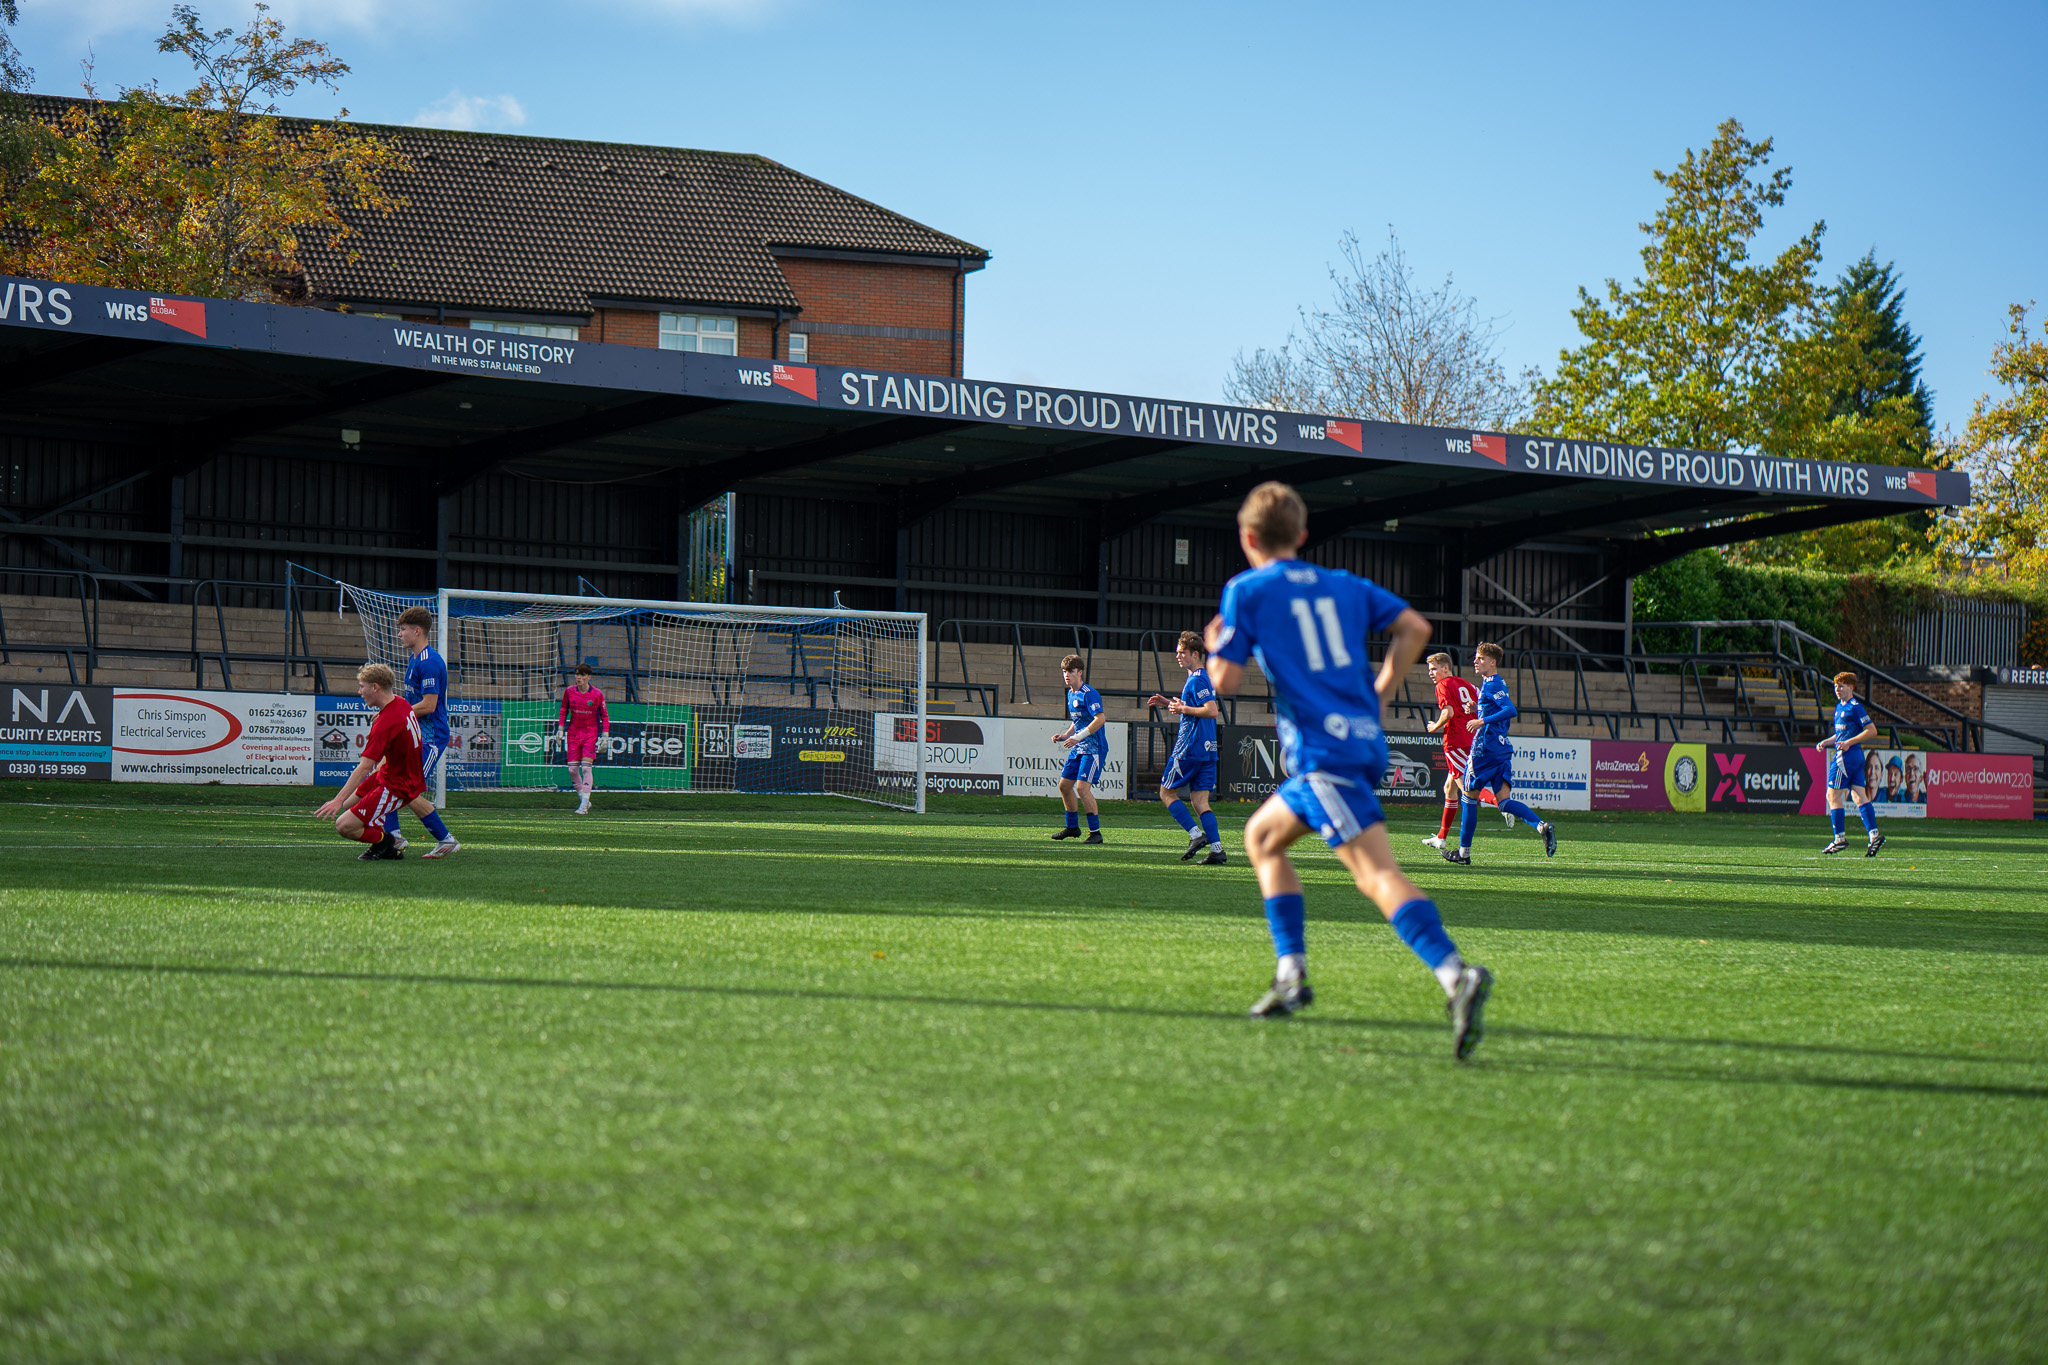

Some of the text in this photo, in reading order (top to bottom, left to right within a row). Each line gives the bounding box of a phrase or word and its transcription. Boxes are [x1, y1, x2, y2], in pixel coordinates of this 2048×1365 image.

[150, 298, 166, 307] ETL
[105, 302, 148, 322] WRS
[150, 307, 177, 316] GLOBAL
[394, 328, 575, 365] WEALTH OF HISTORY
[432, 355, 541, 374] IN THE WRS STAR LANE END
[773, 364, 786, 373] ETL
[738, 369, 772, 387] WRS
[773, 373, 794, 381] GLOBAL
[841, 372, 1278, 445] STANDING PROUD WITH WRS
[1326, 420, 1337, 428] ETL
[1298, 424, 1326, 440] WRS
[1472, 434, 1482, 442] ETL
[1445, 438, 1472, 454] WRS
[1525, 440, 1869, 496] STANDING PROUD WITH WRS
[1885, 475, 1907, 490] WRS
[1290, 597, 1352, 672] 11
[336, 702, 360, 711] HAVE
[471, 704, 482, 712] BY
[137, 708, 162, 721] Chris
[248, 708, 307, 718] 01625 426367
[316, 713, 372, 727] SURETY
[47, 729, 102, 743] EXPERTS
[120, 725, 206, 739] Electrical Services
[248, 725, 306, 735] 07867788049
[785, 726, 821, 734] FOLLOW
[241, 743, 272, 752] Covering
[284, 745, 311, 753] aspects
[519, 731, 683, 760] enprise
[15, 749, 31, 758] stop
[32, 749, 59, 757] hackers
[77, 750, 107, 759] scoring?
[254, 753, 287, 761] Electrical
[320, 750, 350, 758] SURETY
[467, 751, 497, 759] SURETY
[1540, 748, 1577, 760] Home?
[9, 763, 87, 775] 0330 159 5969
[121, 763, 298, 776] www.chrissimpsonelectrical.co.uk
[1595, 760, 1640, 772] AstraZeneca
[1007, 775, 1058, 788] KITCHENS
[1551, 772, 1588, 781] GILMAN
[1744, 768, 1800, 791] recruit
[1942, 768, 2032, 788] powerdown220
[1229, 783, 1256, 793] NETRI
[1410, 790, 1437, 798] SALVAGE
[1511, 793, 1527, 801] 0161
[1529, 793, 1543, 801] 443
